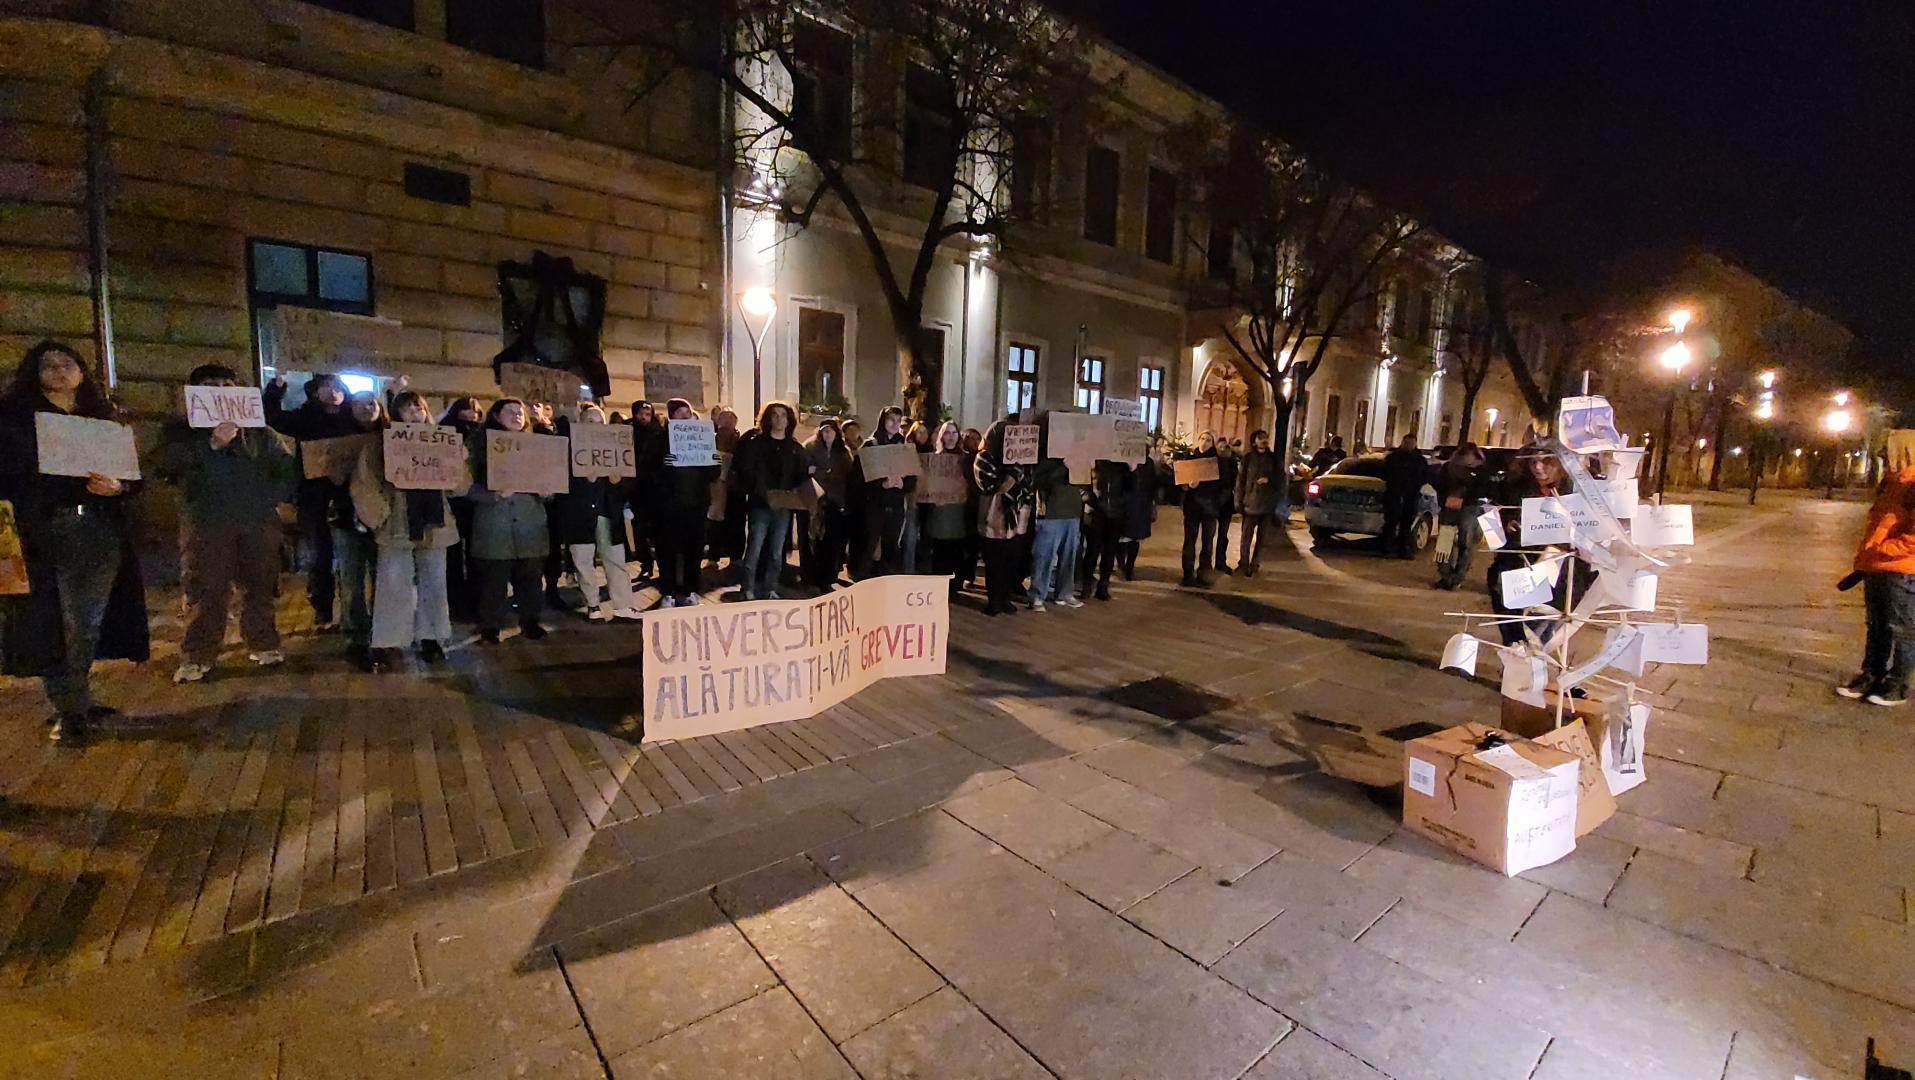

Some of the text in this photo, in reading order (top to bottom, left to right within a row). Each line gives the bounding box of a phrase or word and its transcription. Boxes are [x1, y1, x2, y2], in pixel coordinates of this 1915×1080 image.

[575, 448, 634, 468] CREIC
[906, 592, 934, 607] CSC
[652, 593, 862, 664] UNIVERSITARI,
